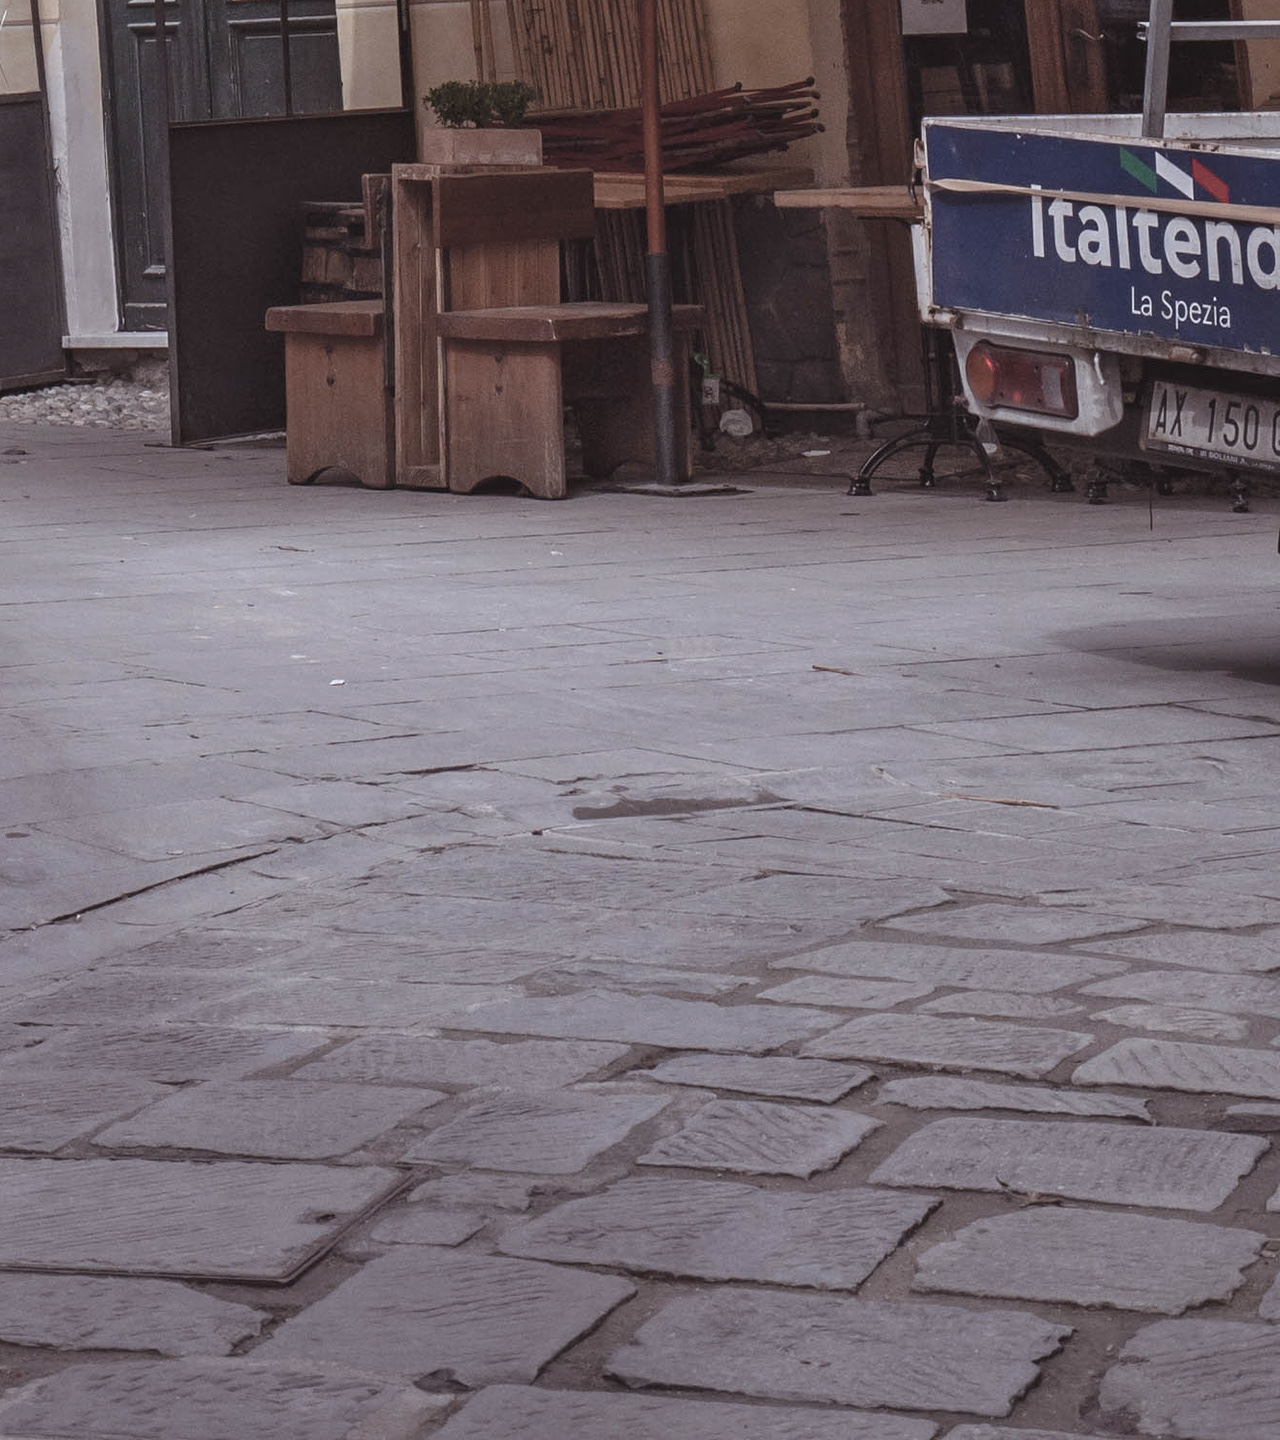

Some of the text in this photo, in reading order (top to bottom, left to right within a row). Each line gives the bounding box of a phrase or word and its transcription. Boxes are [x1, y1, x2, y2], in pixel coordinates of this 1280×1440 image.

[1130, 286, 1232, 330] La Spezia
[1155, 389, 1188, 437] AX
[1207, 398, 1260, 451] 150
